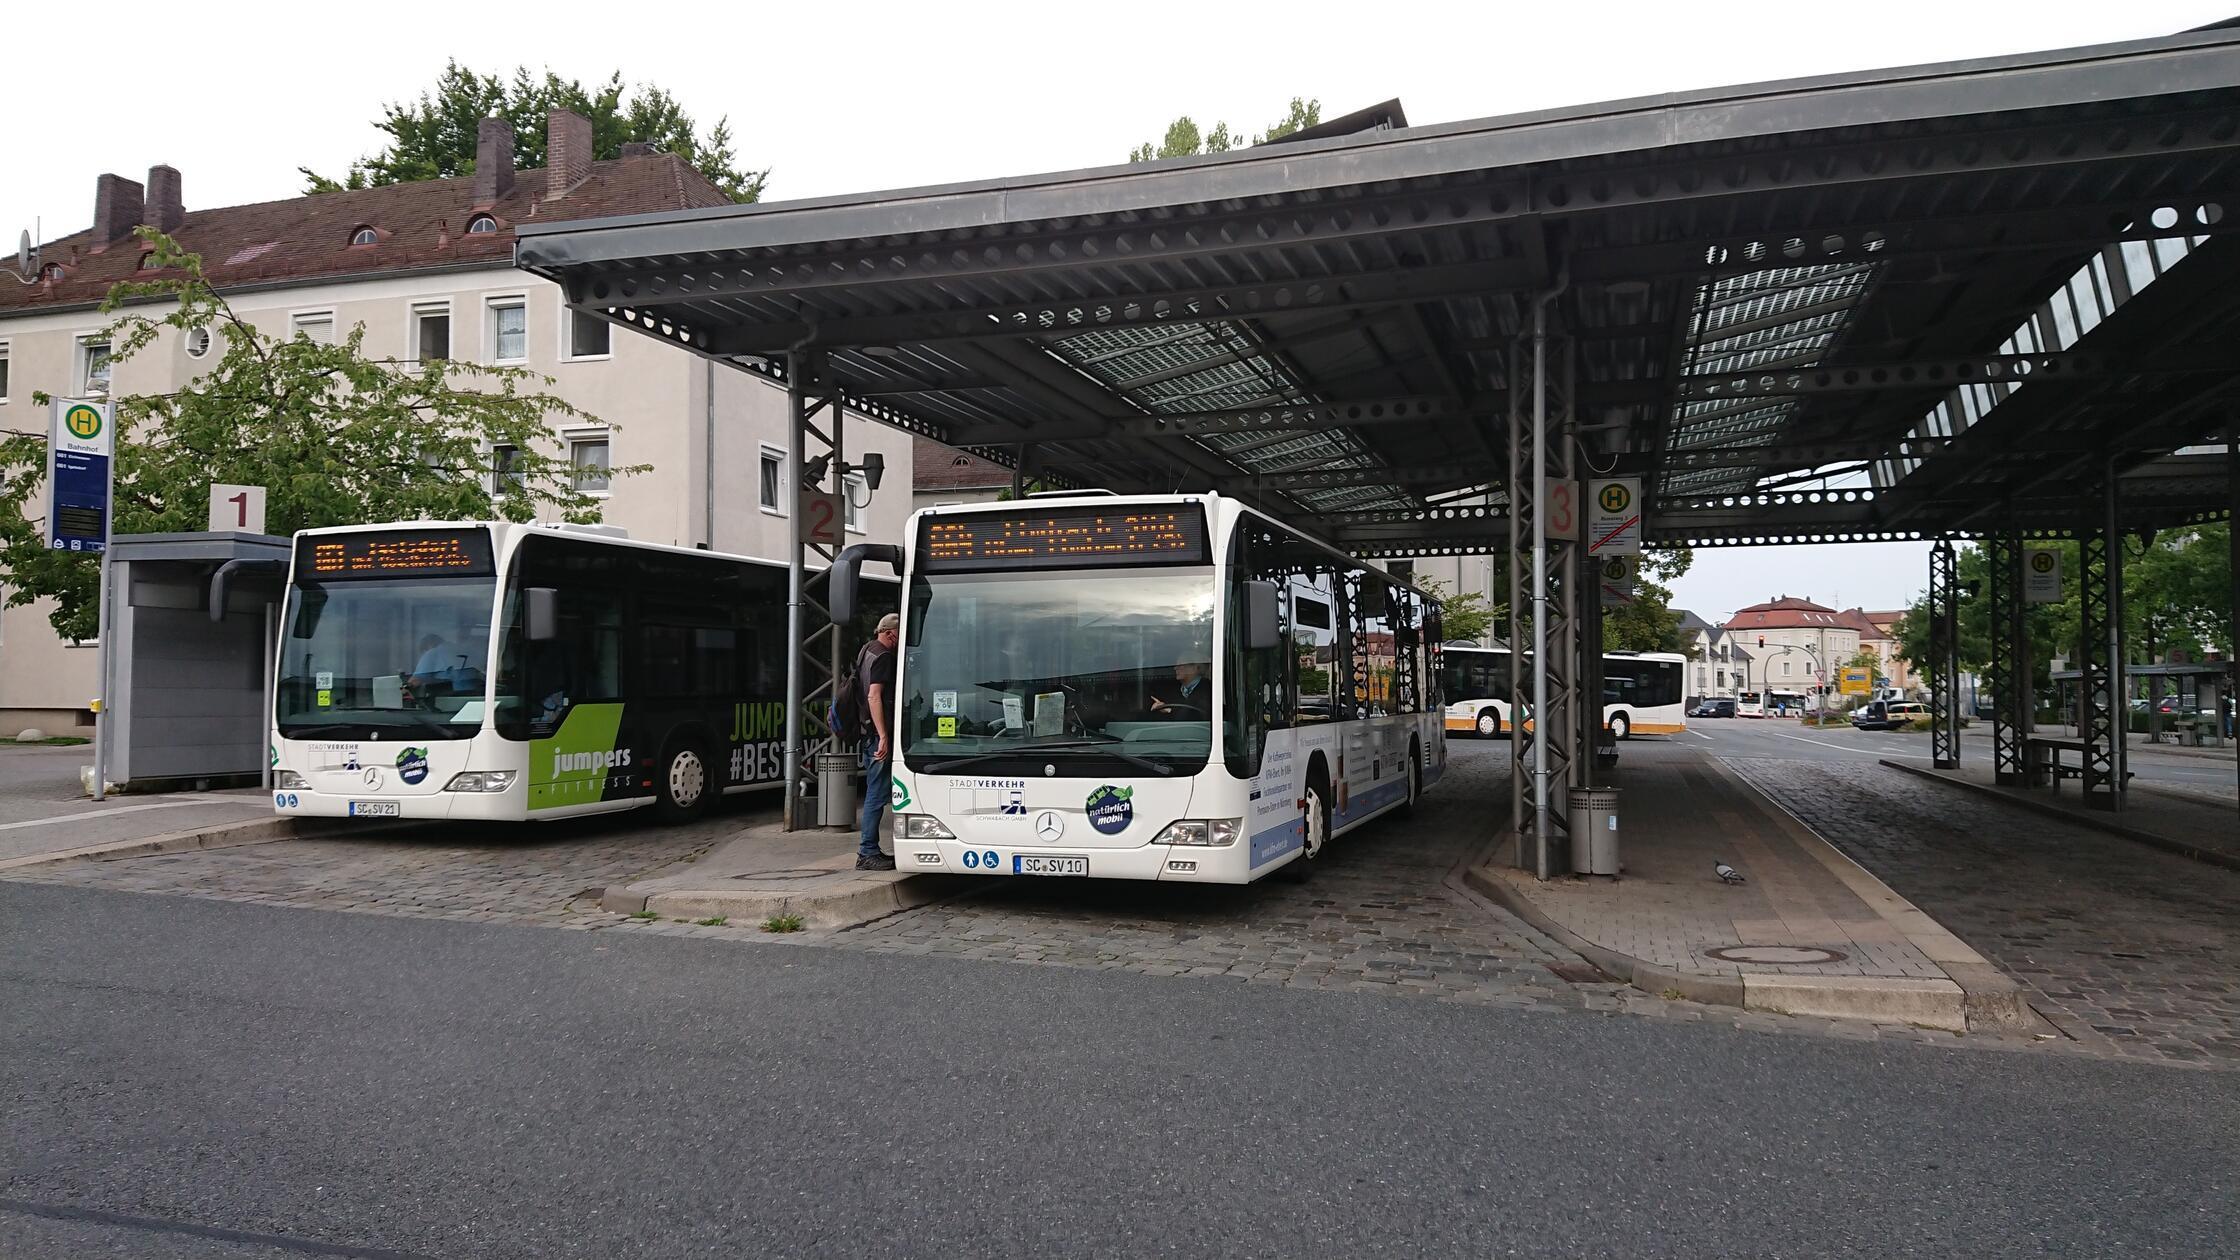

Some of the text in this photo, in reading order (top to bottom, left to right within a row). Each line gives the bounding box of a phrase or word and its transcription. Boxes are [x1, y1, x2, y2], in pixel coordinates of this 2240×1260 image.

[76, 411, 91, 432] H
[68, 443, 98, 453] Bahnhof
[228, 492, 246, 527] 1
[1552, 485, 1571, 532] 3
[809, 499, 834, 538] 2
[552, 747, 631, 780] jumpers
[551, 776, 631, 795] FITNESS
[949, 779, 1025, 788] STADTVERKEHR
[357, 804, 394, 814] SC SV 21
[1090, 802, 1130, 817] natürlich
[1097, 813, 1123, 825] mobil
[1026, 859, 1082, 873] SC SV 10
